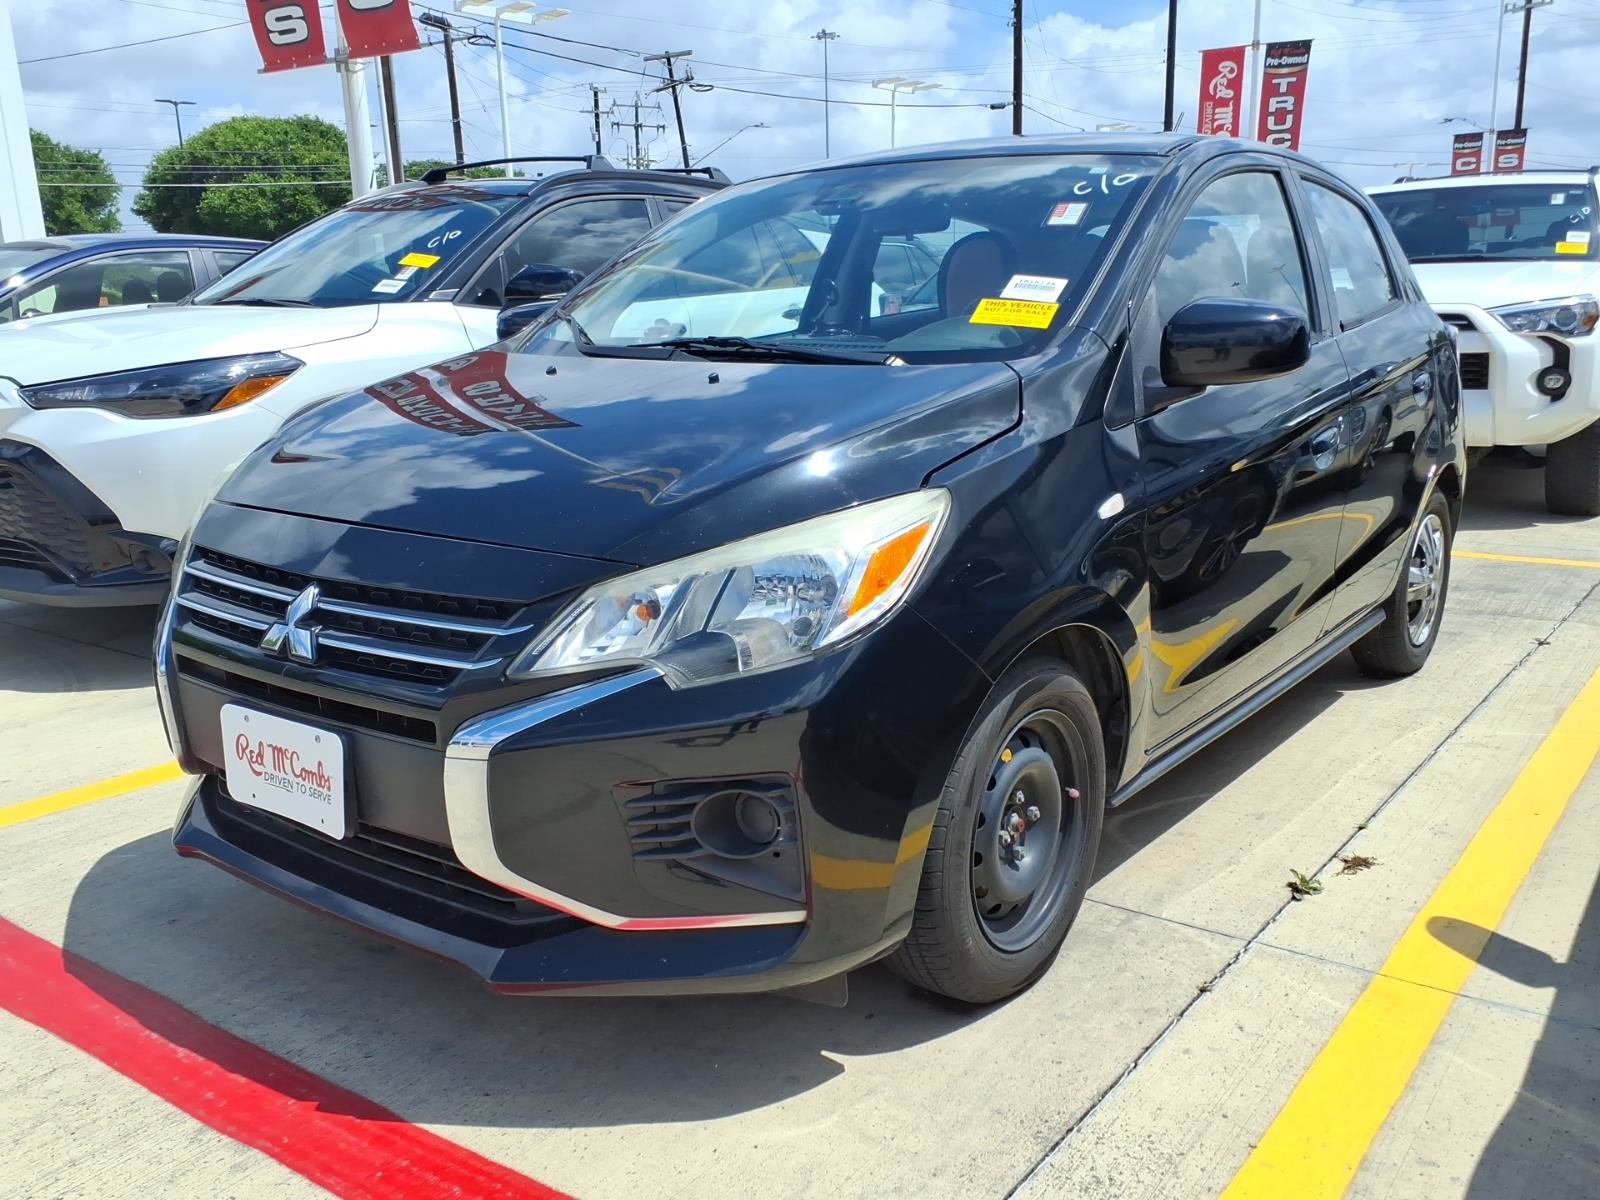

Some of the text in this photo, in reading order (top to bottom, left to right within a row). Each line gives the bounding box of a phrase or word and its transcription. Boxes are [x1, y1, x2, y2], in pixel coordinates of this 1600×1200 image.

[264, 4, 309, 46] S
[1209, 61, 1238, 100] Red
[985, 300, 1056, 312] THIS VEHICLE
[235, 733, 332, 793] Red McCombs
[264, 771, 333, 806] DRIVEN TO SERVE
